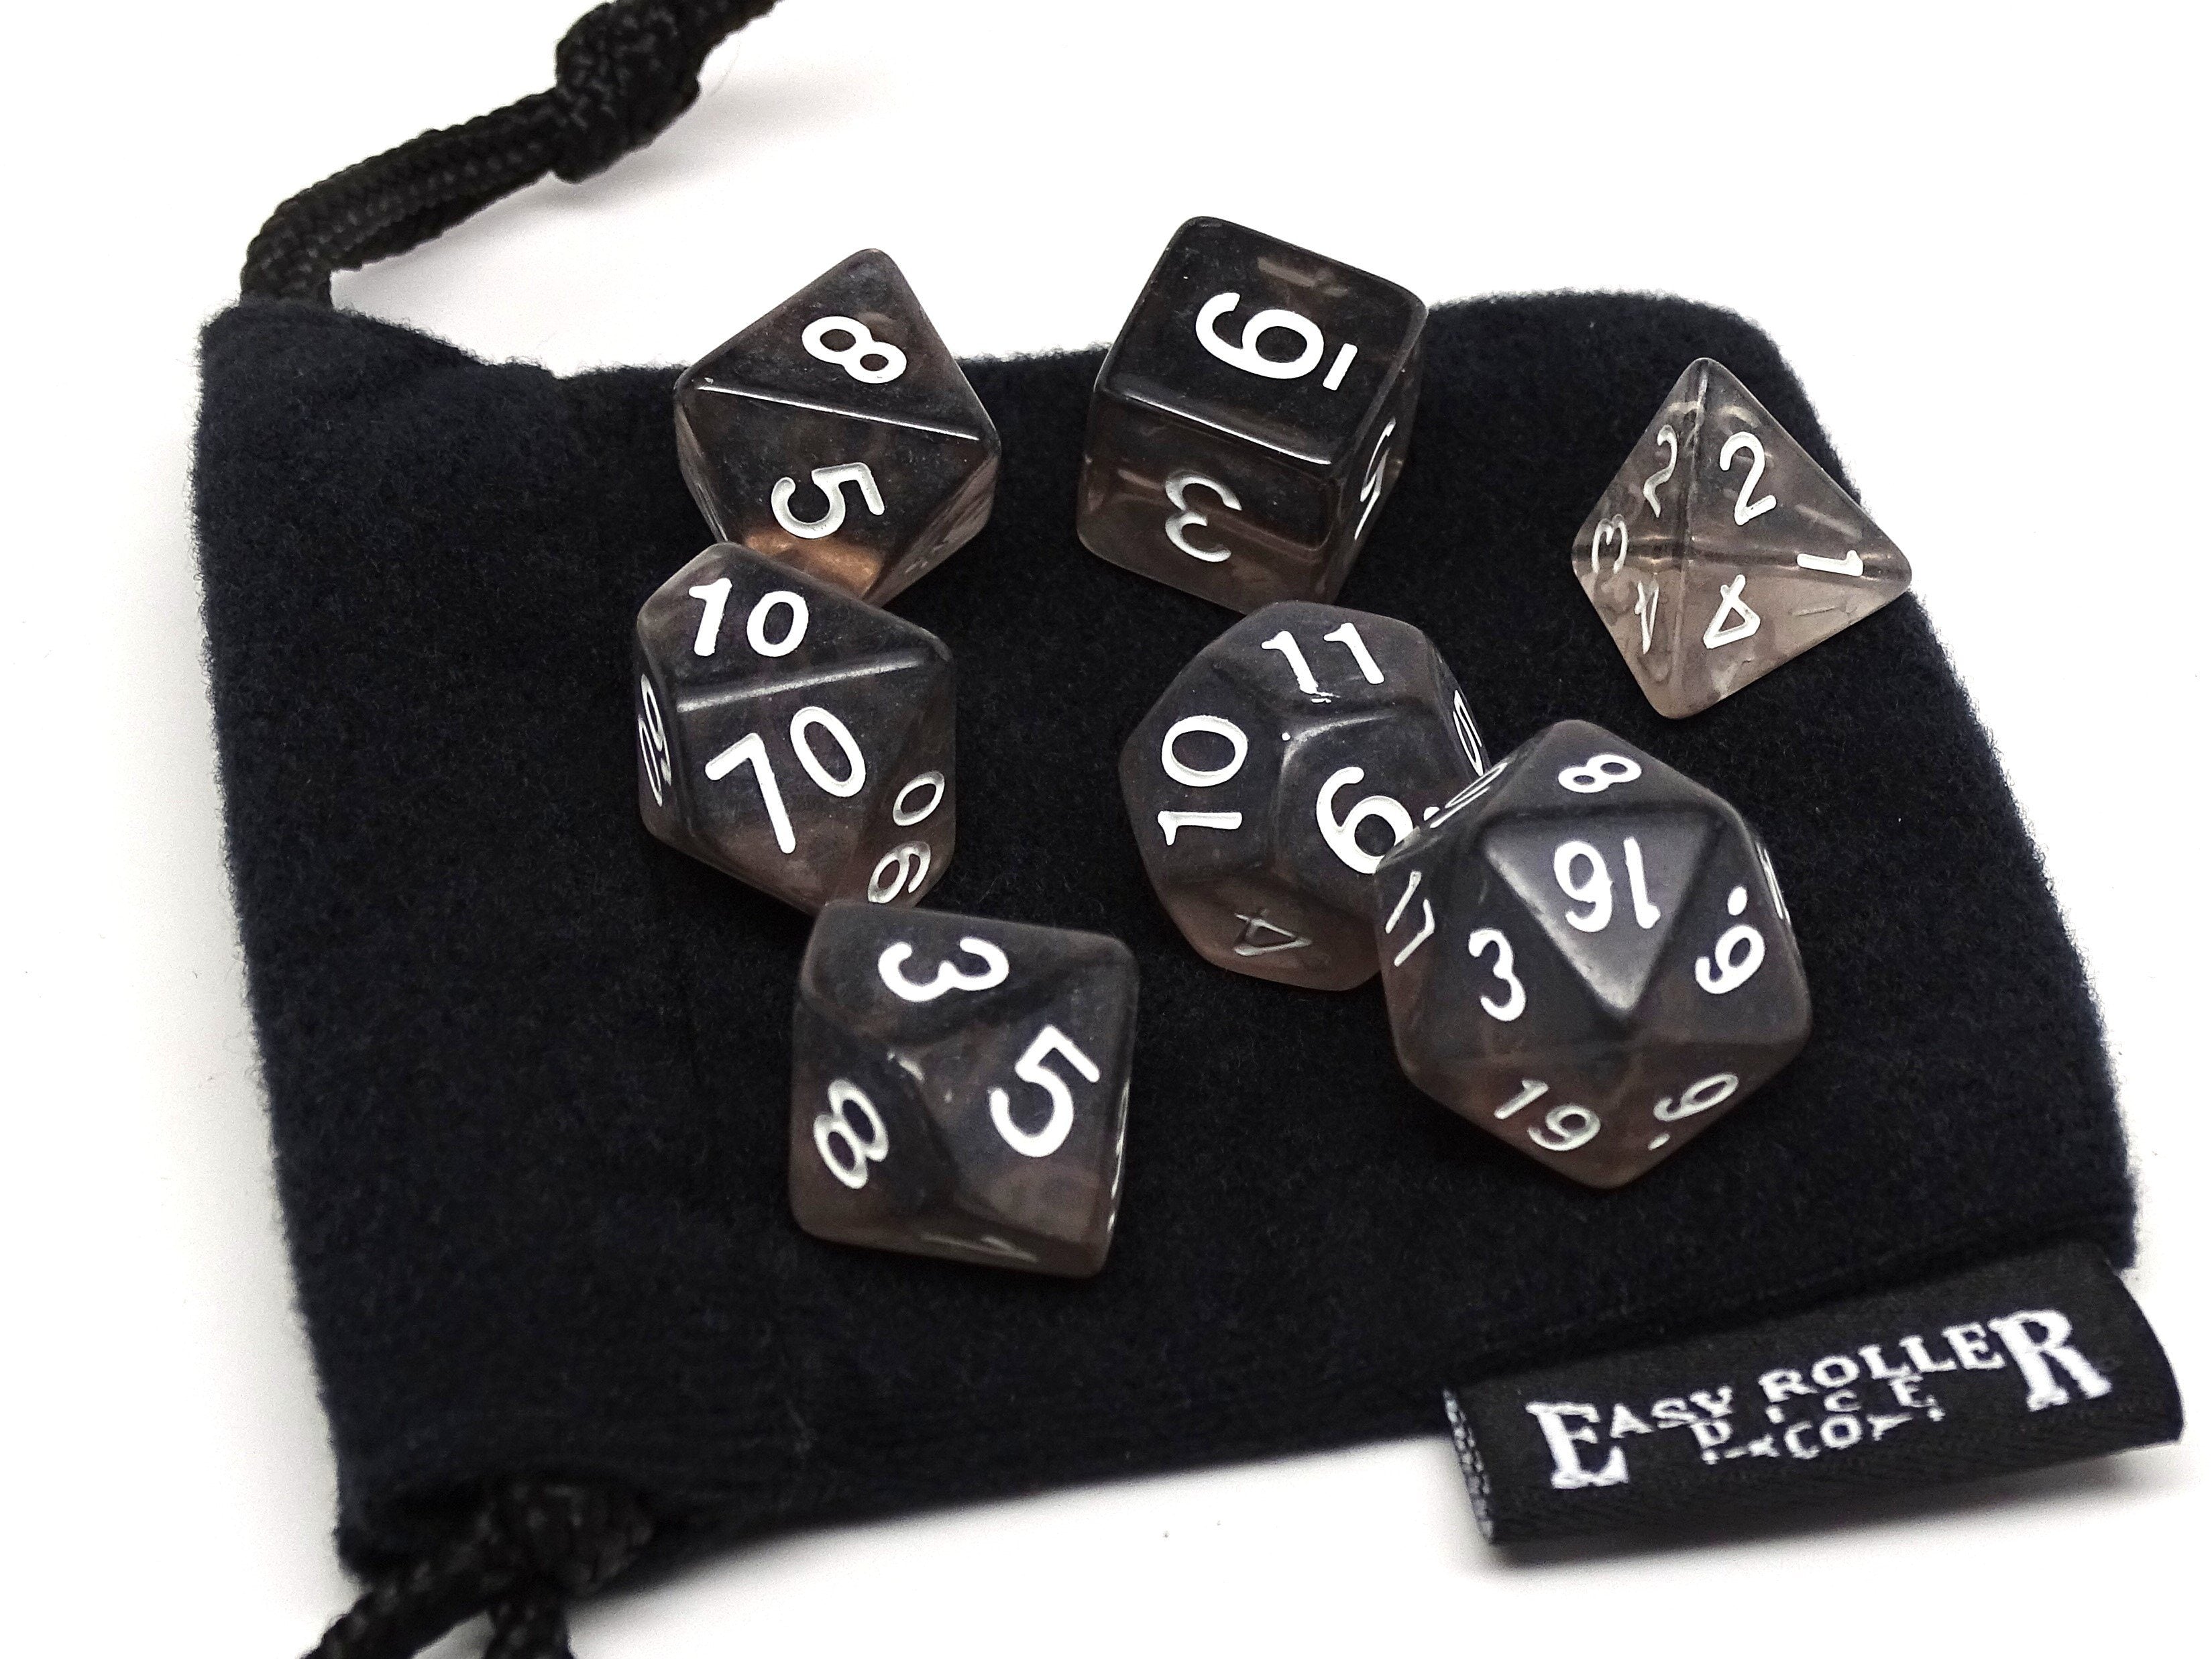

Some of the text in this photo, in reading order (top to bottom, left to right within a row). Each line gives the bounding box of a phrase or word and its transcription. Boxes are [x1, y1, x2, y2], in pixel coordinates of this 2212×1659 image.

[801, 315, 907, 384] 8
[770, 461, 886, 540] 5
[1643, 424, 1677, 517] 2
[1719, 431, 1777, 526] 2
[1164, 468, 1242, 563] 3
[1592, 514, 1628, 574] 3
[1796, 550, 1864, 577] 1
[687, 576, 810, 658] 10
[1703, 574, 1761, 649] 4
[1261, 623, 1385, 702] 11
[704, 706, 867, 854] 70
[1156, 714, 1250, 847] 10
[1557, 751, 1643, 794] 8
[1553, 836, 1661, 932] 16
[877, 935, 1010, 1004] 3
[1468, 926, 1527, 1022] 3
[812, 1078, 889, 1189] 8
[987, 1023, 1101, 1159] 5
[1494, 1079, 1601, 1151] 19
[1525, 1309, 2112, 1489] EASY ROLLER
